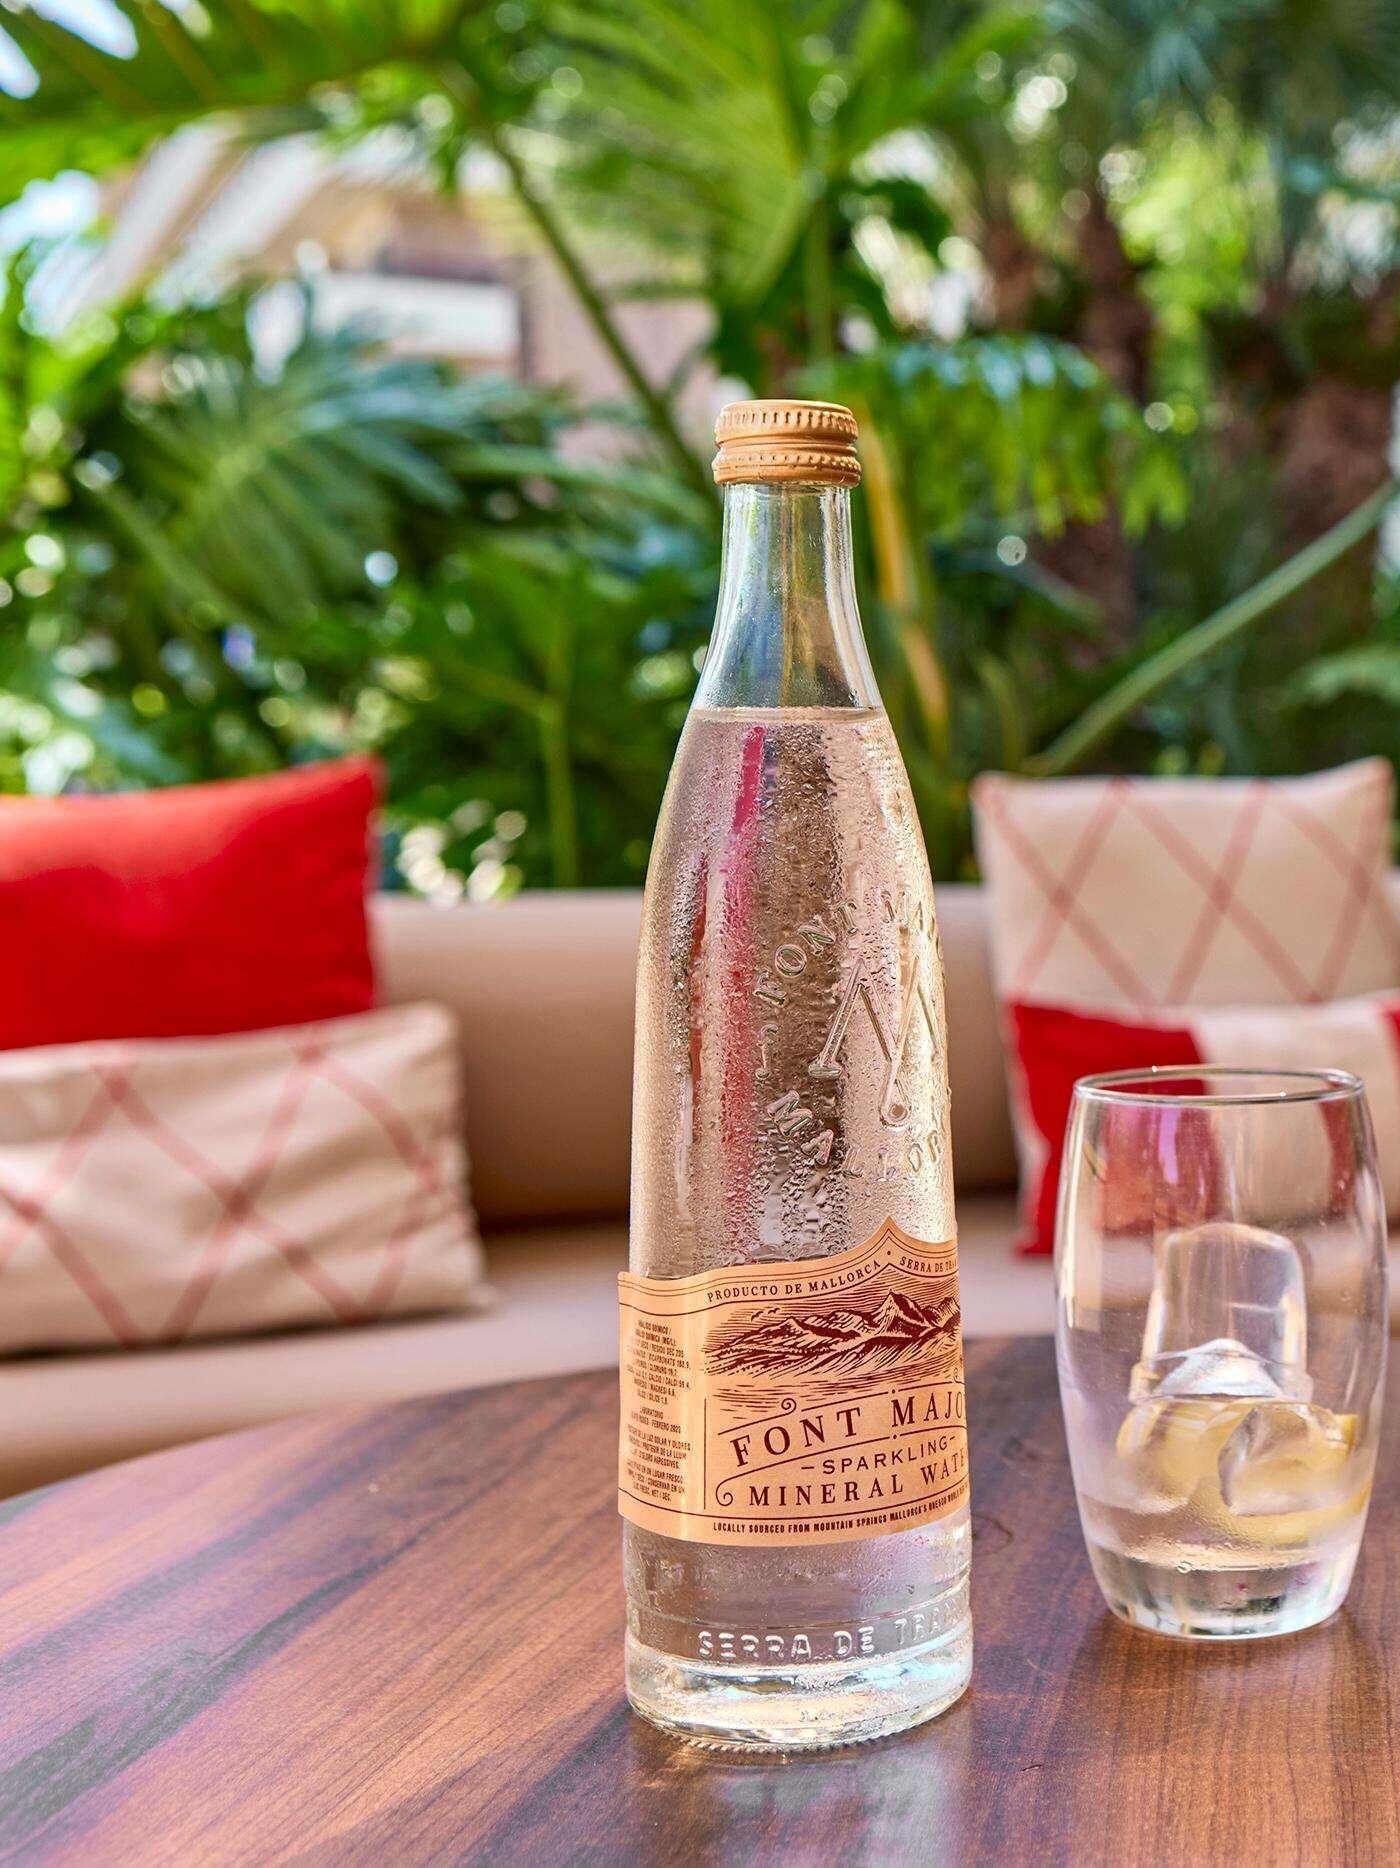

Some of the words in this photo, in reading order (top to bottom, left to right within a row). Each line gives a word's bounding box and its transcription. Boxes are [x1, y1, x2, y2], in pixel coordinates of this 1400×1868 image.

[707, 1285, 778, 1302] PRODUCTO
[785, 1283, 802, 1295] DE
[809, 1259, 881, 1292] MALLORCA
[900, 1256, 931, 1273] SERRA
[935, 1262, 943, 1273] DE
[730, 1407, 861, 1467] FONT
[891, 1391, 963, 1428] MAJO
[822, 1435, 948, 1475] SPARKLING
[749, 1474, 903, 1506] MINERAL
[920, 1447, 964, 1485] WATE
[713, 1522, 745, 1533] LOCALLY
[749, 1524, 785, 1533] SOURCED
[788, 1523, 810, 1533] FROM
[813, 1520, 853, 1532] MOUNTAIN
[856, 1514, 887, 1528] SPRINGS
[698, 1630, 812, 1660] SERRA
[833, 1625, 874, 1656] DE
